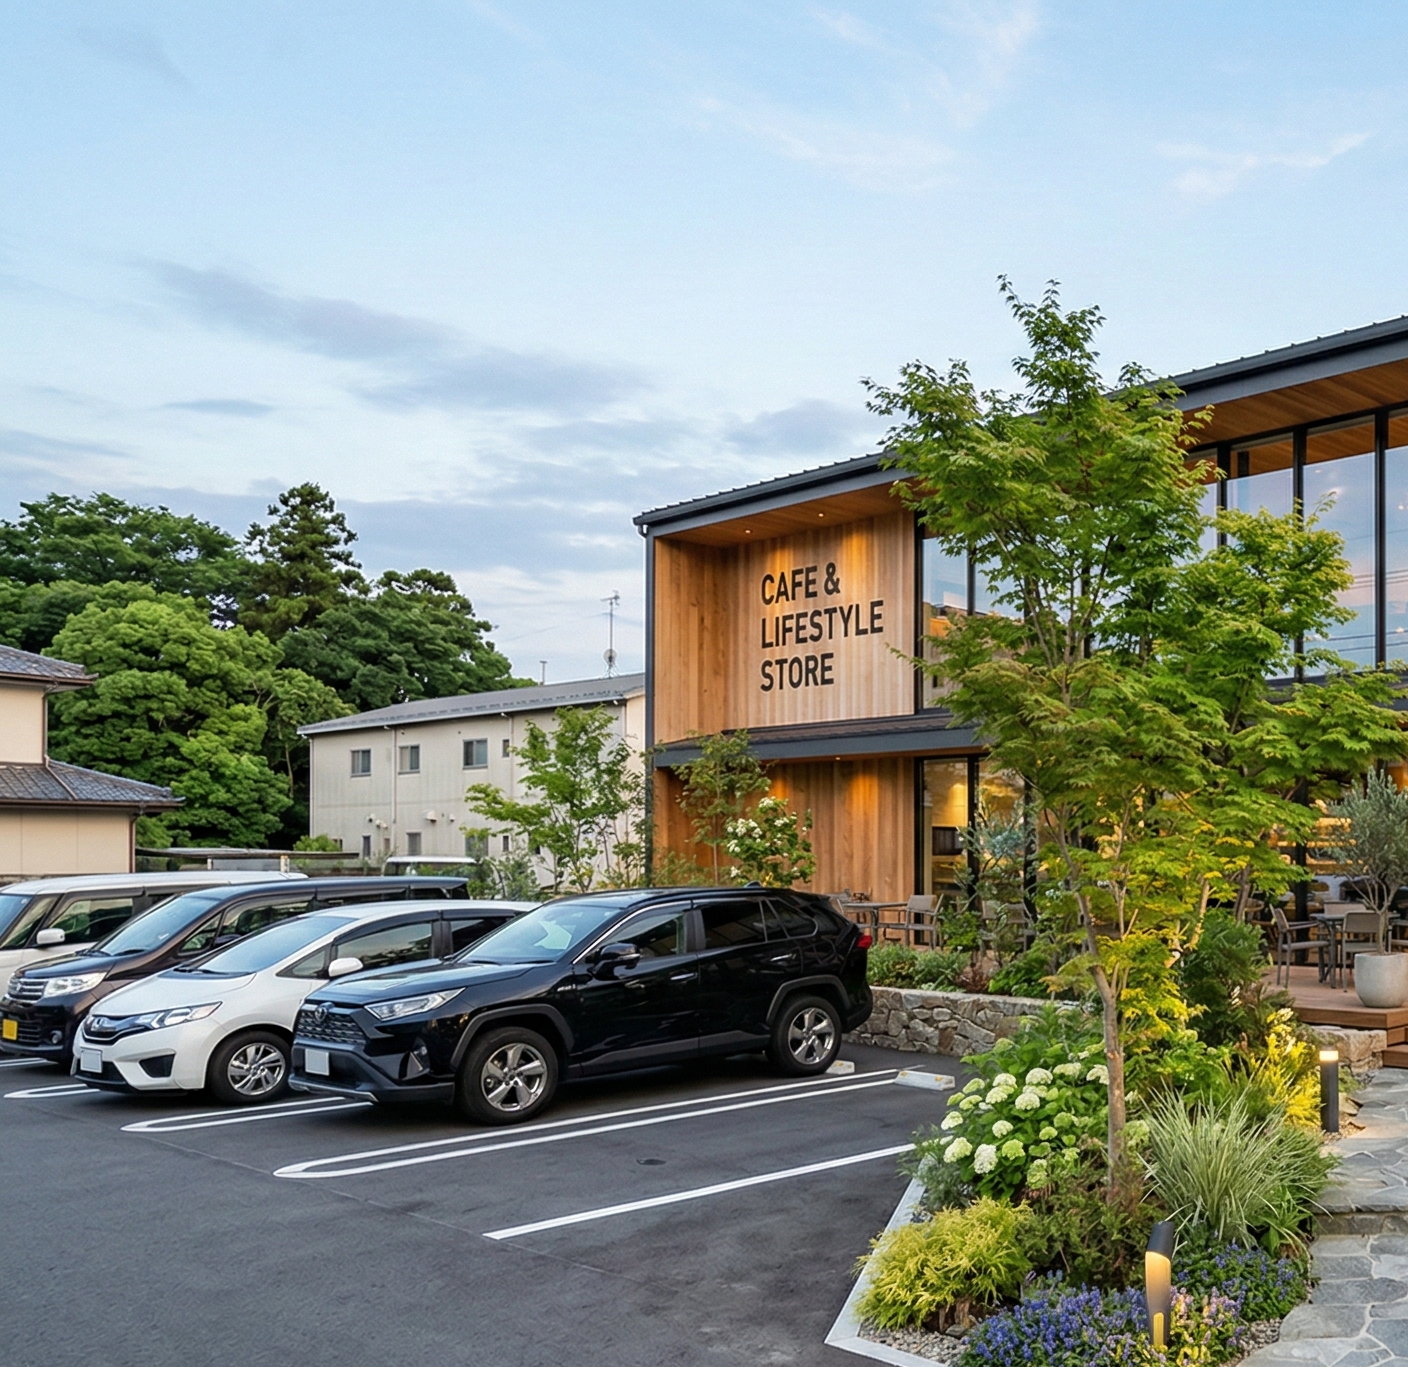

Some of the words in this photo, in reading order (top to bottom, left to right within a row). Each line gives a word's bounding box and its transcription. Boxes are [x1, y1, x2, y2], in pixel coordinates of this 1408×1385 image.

[761, 565, 818, 605] CAFE
[823, 562, 841, 595] &
[761, 600, 884, 649] LIFESTYLE
[760, 652, 835, 692] STORE
